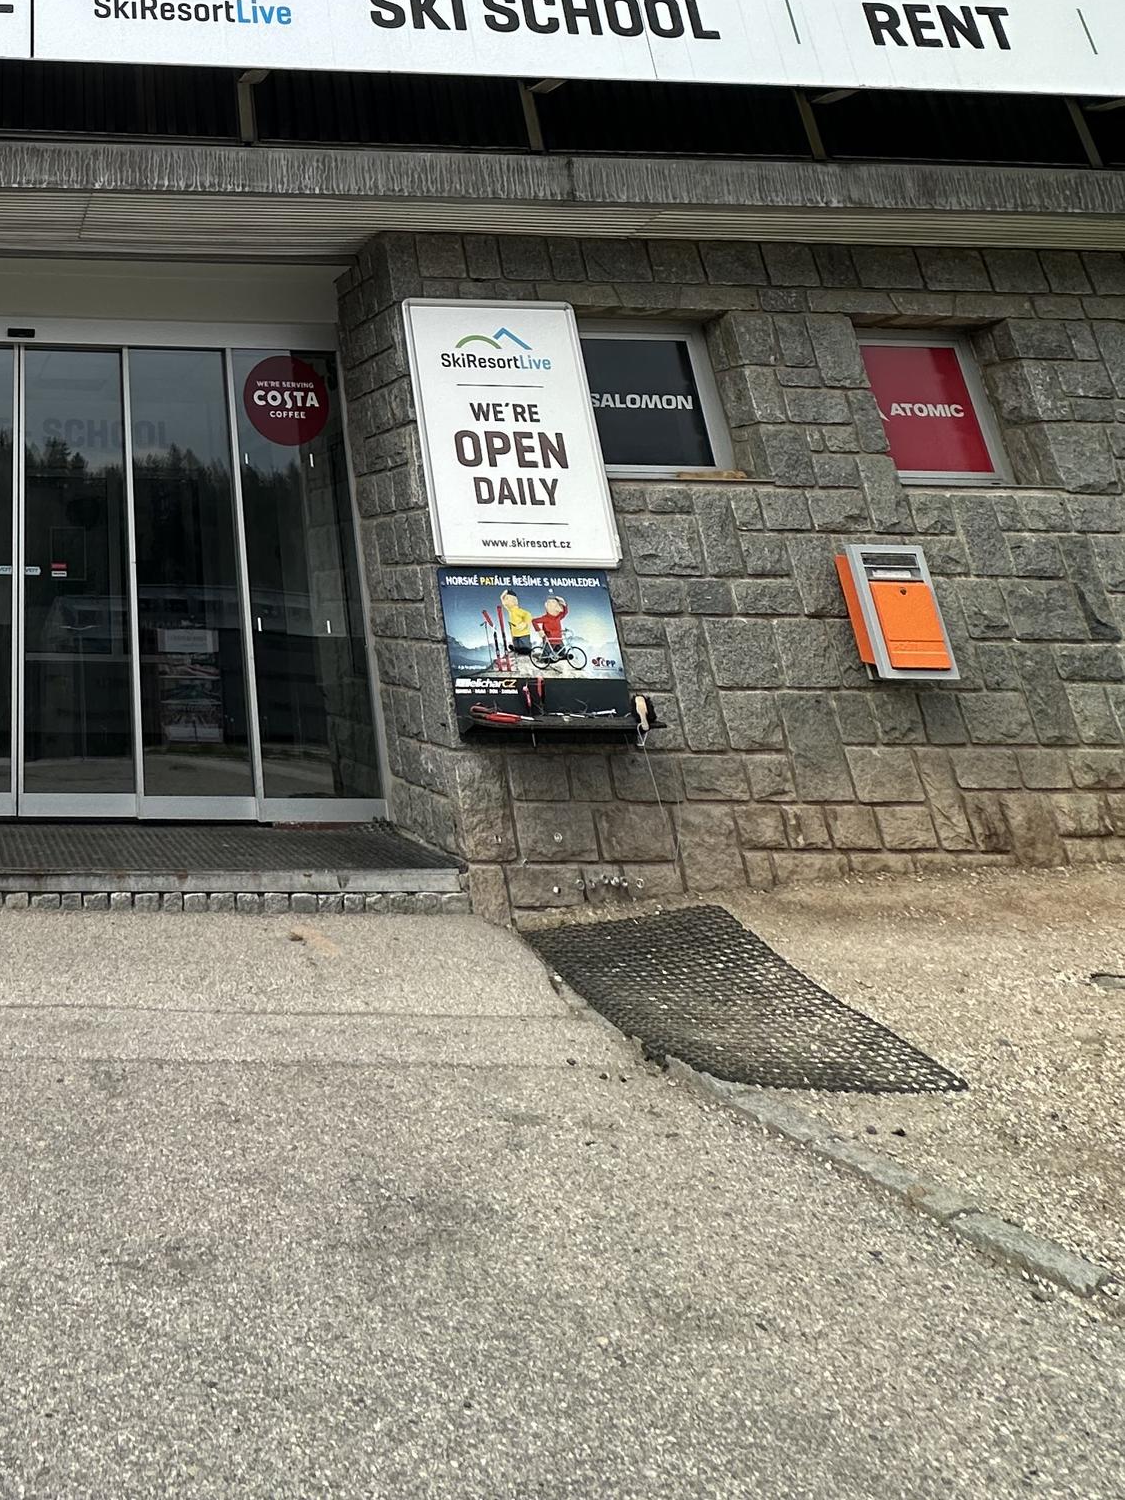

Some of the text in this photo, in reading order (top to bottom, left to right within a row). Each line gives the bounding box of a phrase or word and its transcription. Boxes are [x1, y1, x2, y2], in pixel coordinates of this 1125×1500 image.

[861, 1, 1011, 52] RENT
[441, 353, 551, 370] SkiResortLive
[282, 381, 314, 389] SERVING
[254, 390, 319, 409] COSTA
[590, 392, 693, 410] SALOMON
[270, 411, 306, 419] COFFEE
[890, 402, 964, 418] ATOMIC
[454, 430, 569, 469] OPEN
[473, 477, 558, 506] DAILY
[482, 536, 572, 549] www.skiresort.cz
[446, 575, 600, 587] HORSKÉ PATÁLIE ŘEŠÍME S NADHLEDEM
